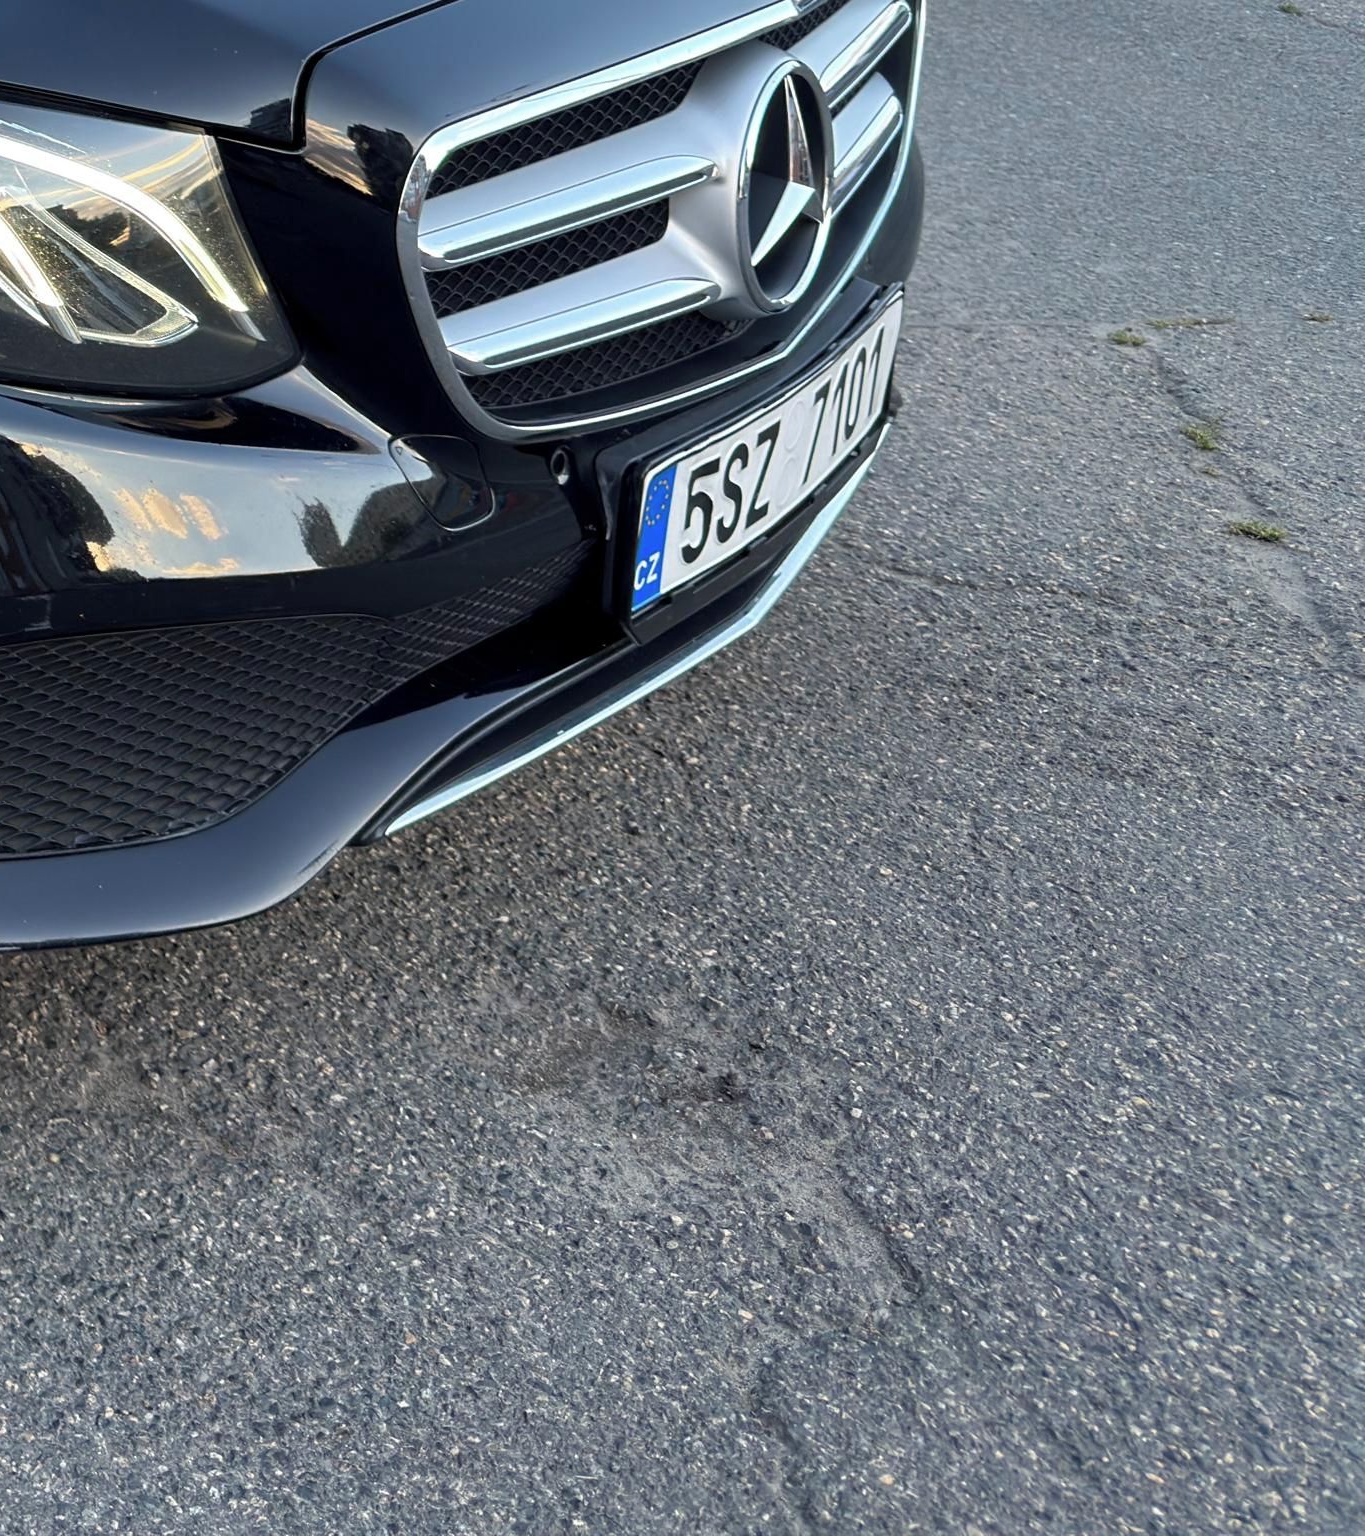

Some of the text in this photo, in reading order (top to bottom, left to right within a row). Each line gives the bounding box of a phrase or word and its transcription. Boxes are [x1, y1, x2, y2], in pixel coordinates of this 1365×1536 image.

[681, 325, 885, 564] 5SZ 7101
[633, 551, 661, 591] CZ
